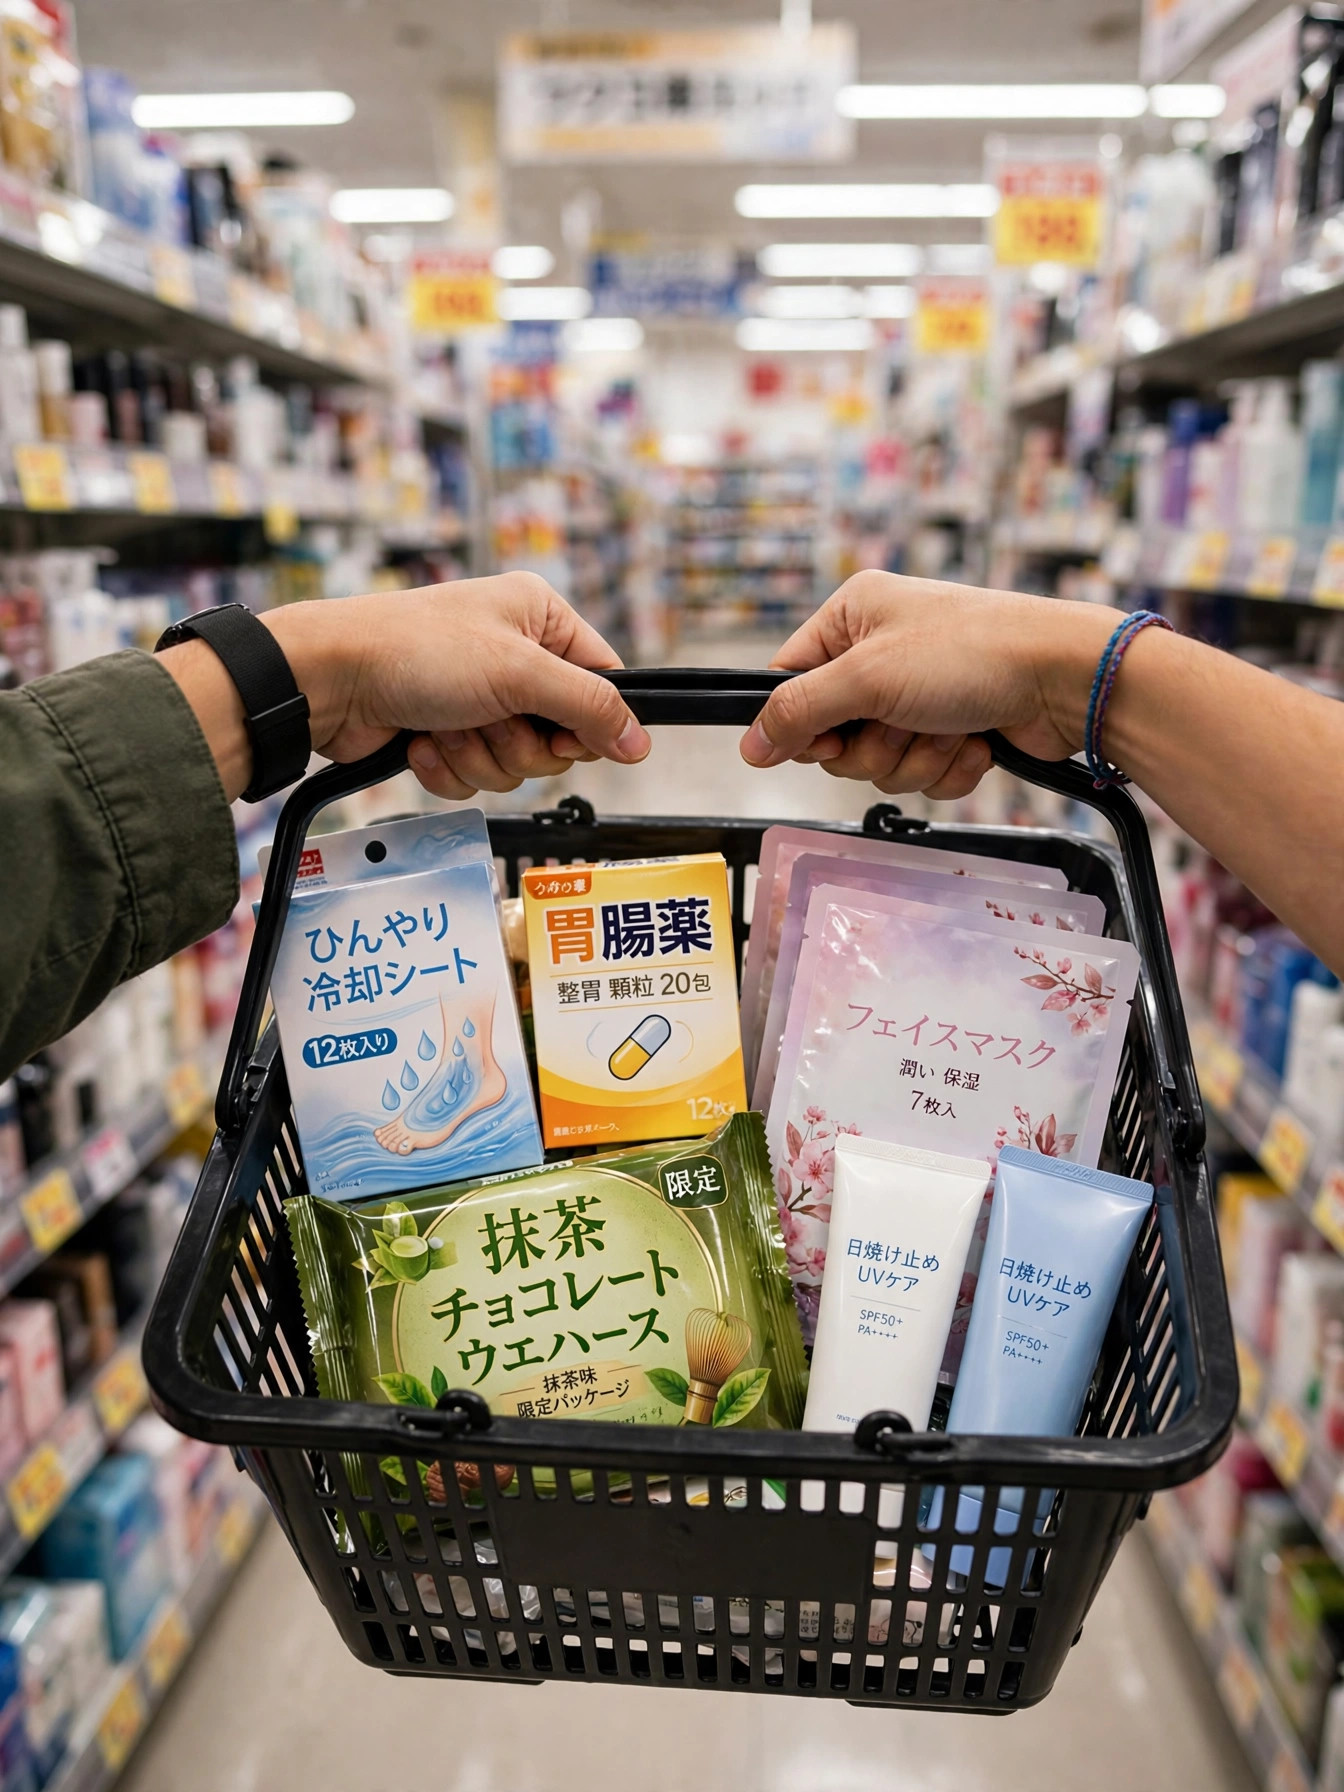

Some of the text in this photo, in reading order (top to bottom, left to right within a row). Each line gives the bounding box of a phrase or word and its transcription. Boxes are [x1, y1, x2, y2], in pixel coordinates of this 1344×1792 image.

[305, 903, 449, 964] ひんやり
[546, 898, 713, 964] 胃腸薬
[303, 947, 478, 1013] 冷却シート
[557, 971, 712, 1004] 整胃 顆粒 20包
[309, 1036, 390, 1065] 12枚入り
[846, 1003, 1056, 1069] フェイスマスク
[900, 1058, 980, 1092] 潤い 保湿
[911, 1089, 957, 1119] 7枚入
[665, 1165, 722, 1200] 限定
[478, 1195, 606, 1275] 抹茶
[847, 1239, 940, 1272] 日焼け止め
[857, 1266, 919, 1292] UVケア
[999, 1257, 1092, 1299] 日焼け止め
[430, 1249, 679, 1342] チョコレート
[1006, 1286, 1071, 1317] UVケア
[860, 1309, 903, 1326] SPF50+
[457, 1307, 670, 1386] ウエハース
[1006, 1330, 1049, 1351] SPF50+
[543, 1365, 598, 1394] 抹茶味
[517, 1379, 630, 1419] 限定パッケージ
